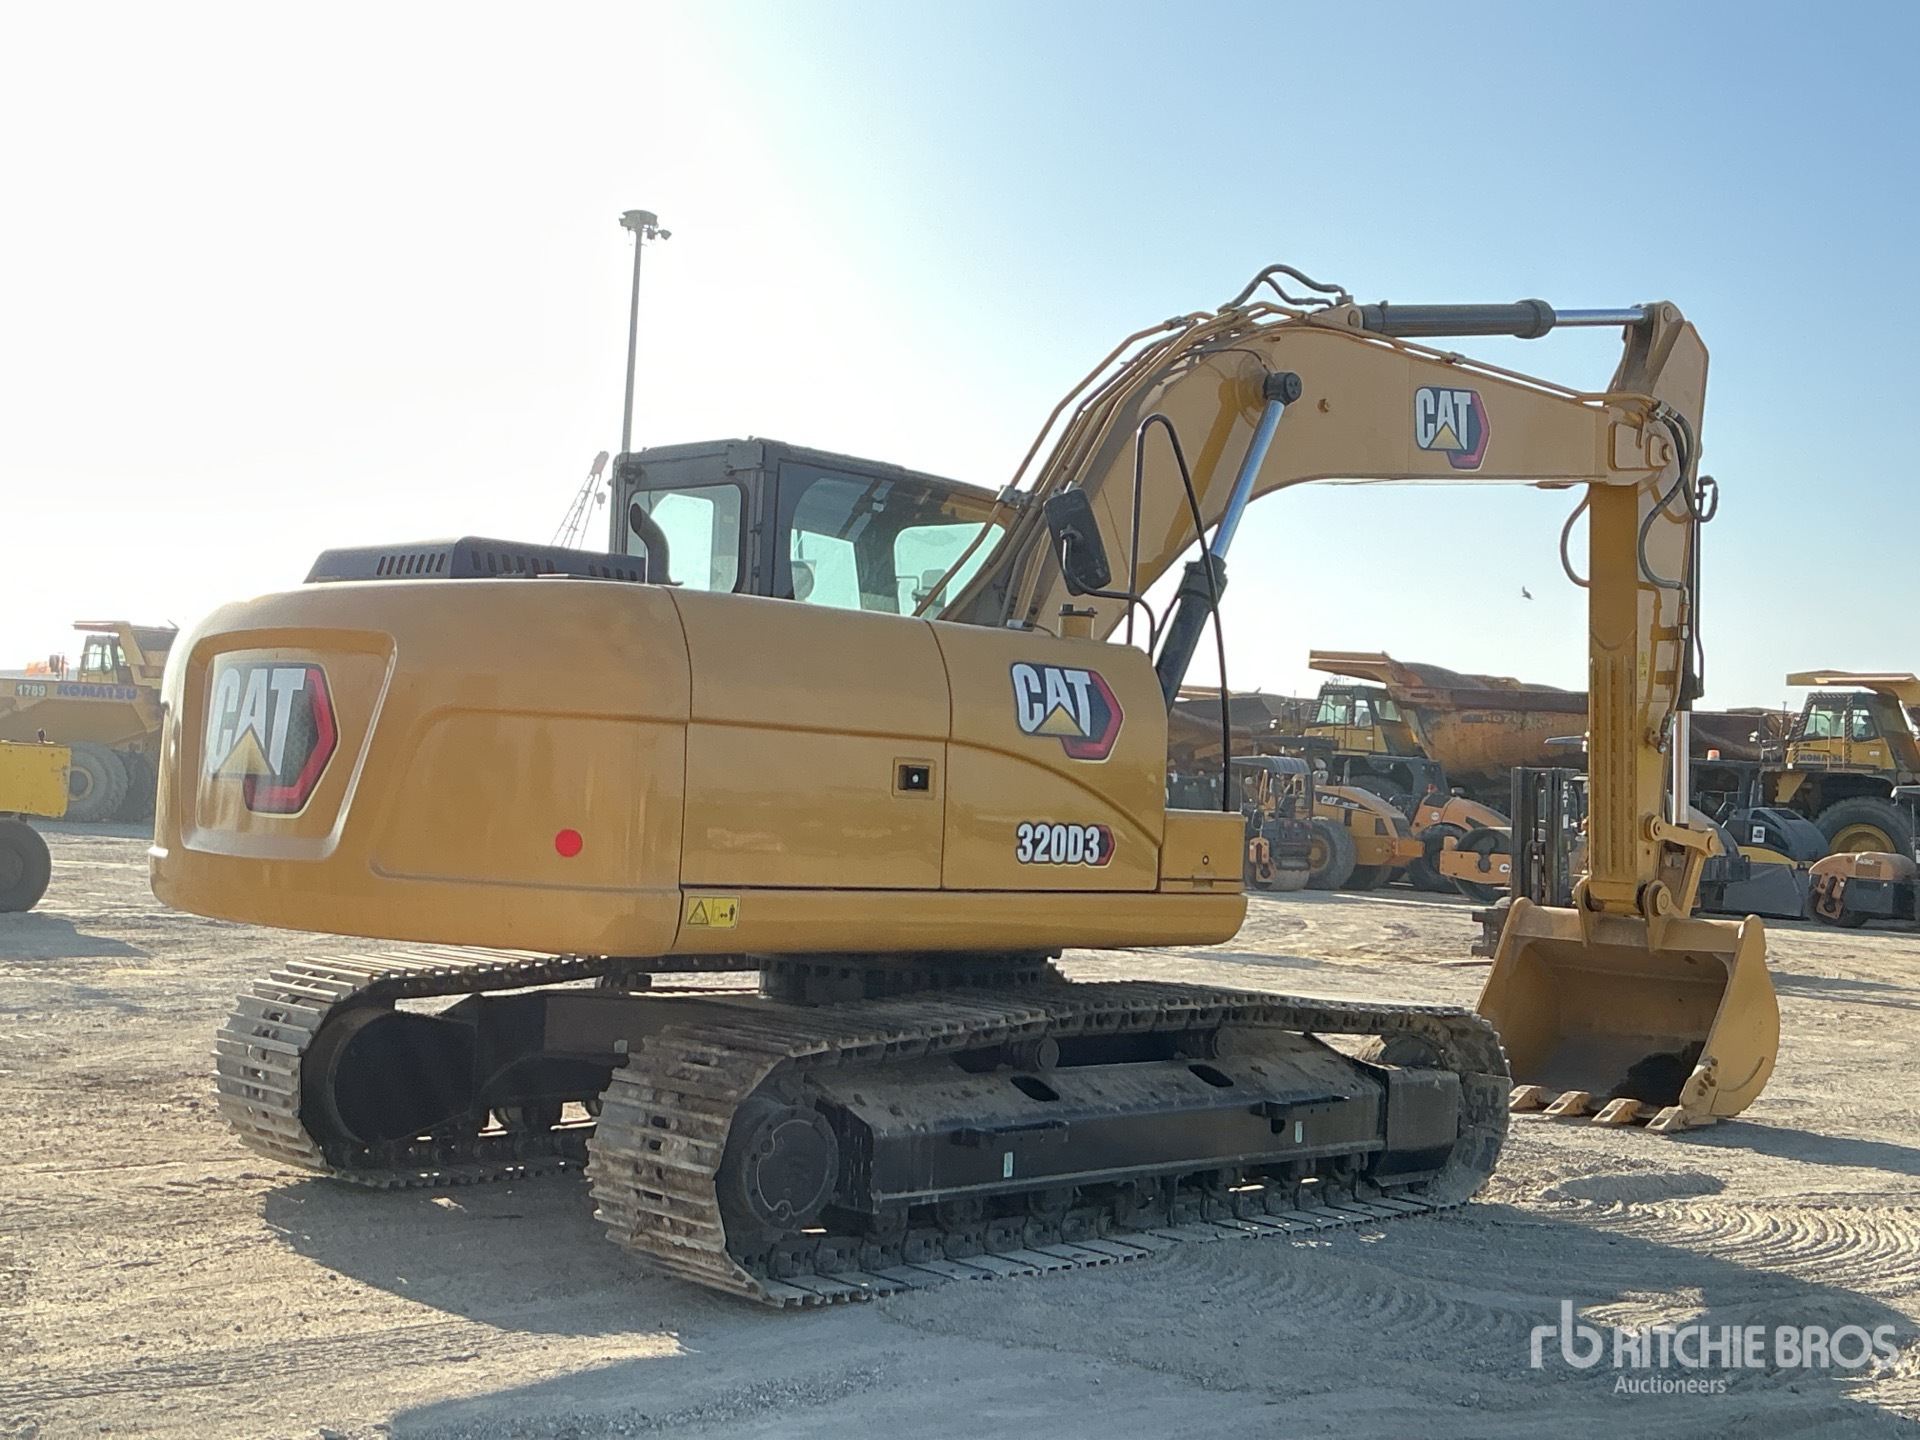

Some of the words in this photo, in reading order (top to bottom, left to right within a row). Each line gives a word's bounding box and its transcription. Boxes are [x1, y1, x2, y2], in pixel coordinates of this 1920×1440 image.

[1416, 388, 1472, 450] CAT
[17, 684, 46, 696] 1789
[57, 684, 137, 699] KOMATSU
[1012, 664, 1091, 737] CAT
[206, 668, 306, 775] CAT
[1321, 795, 1339, 805] CAT
[1017, 823, 1100, 864] 320D3
